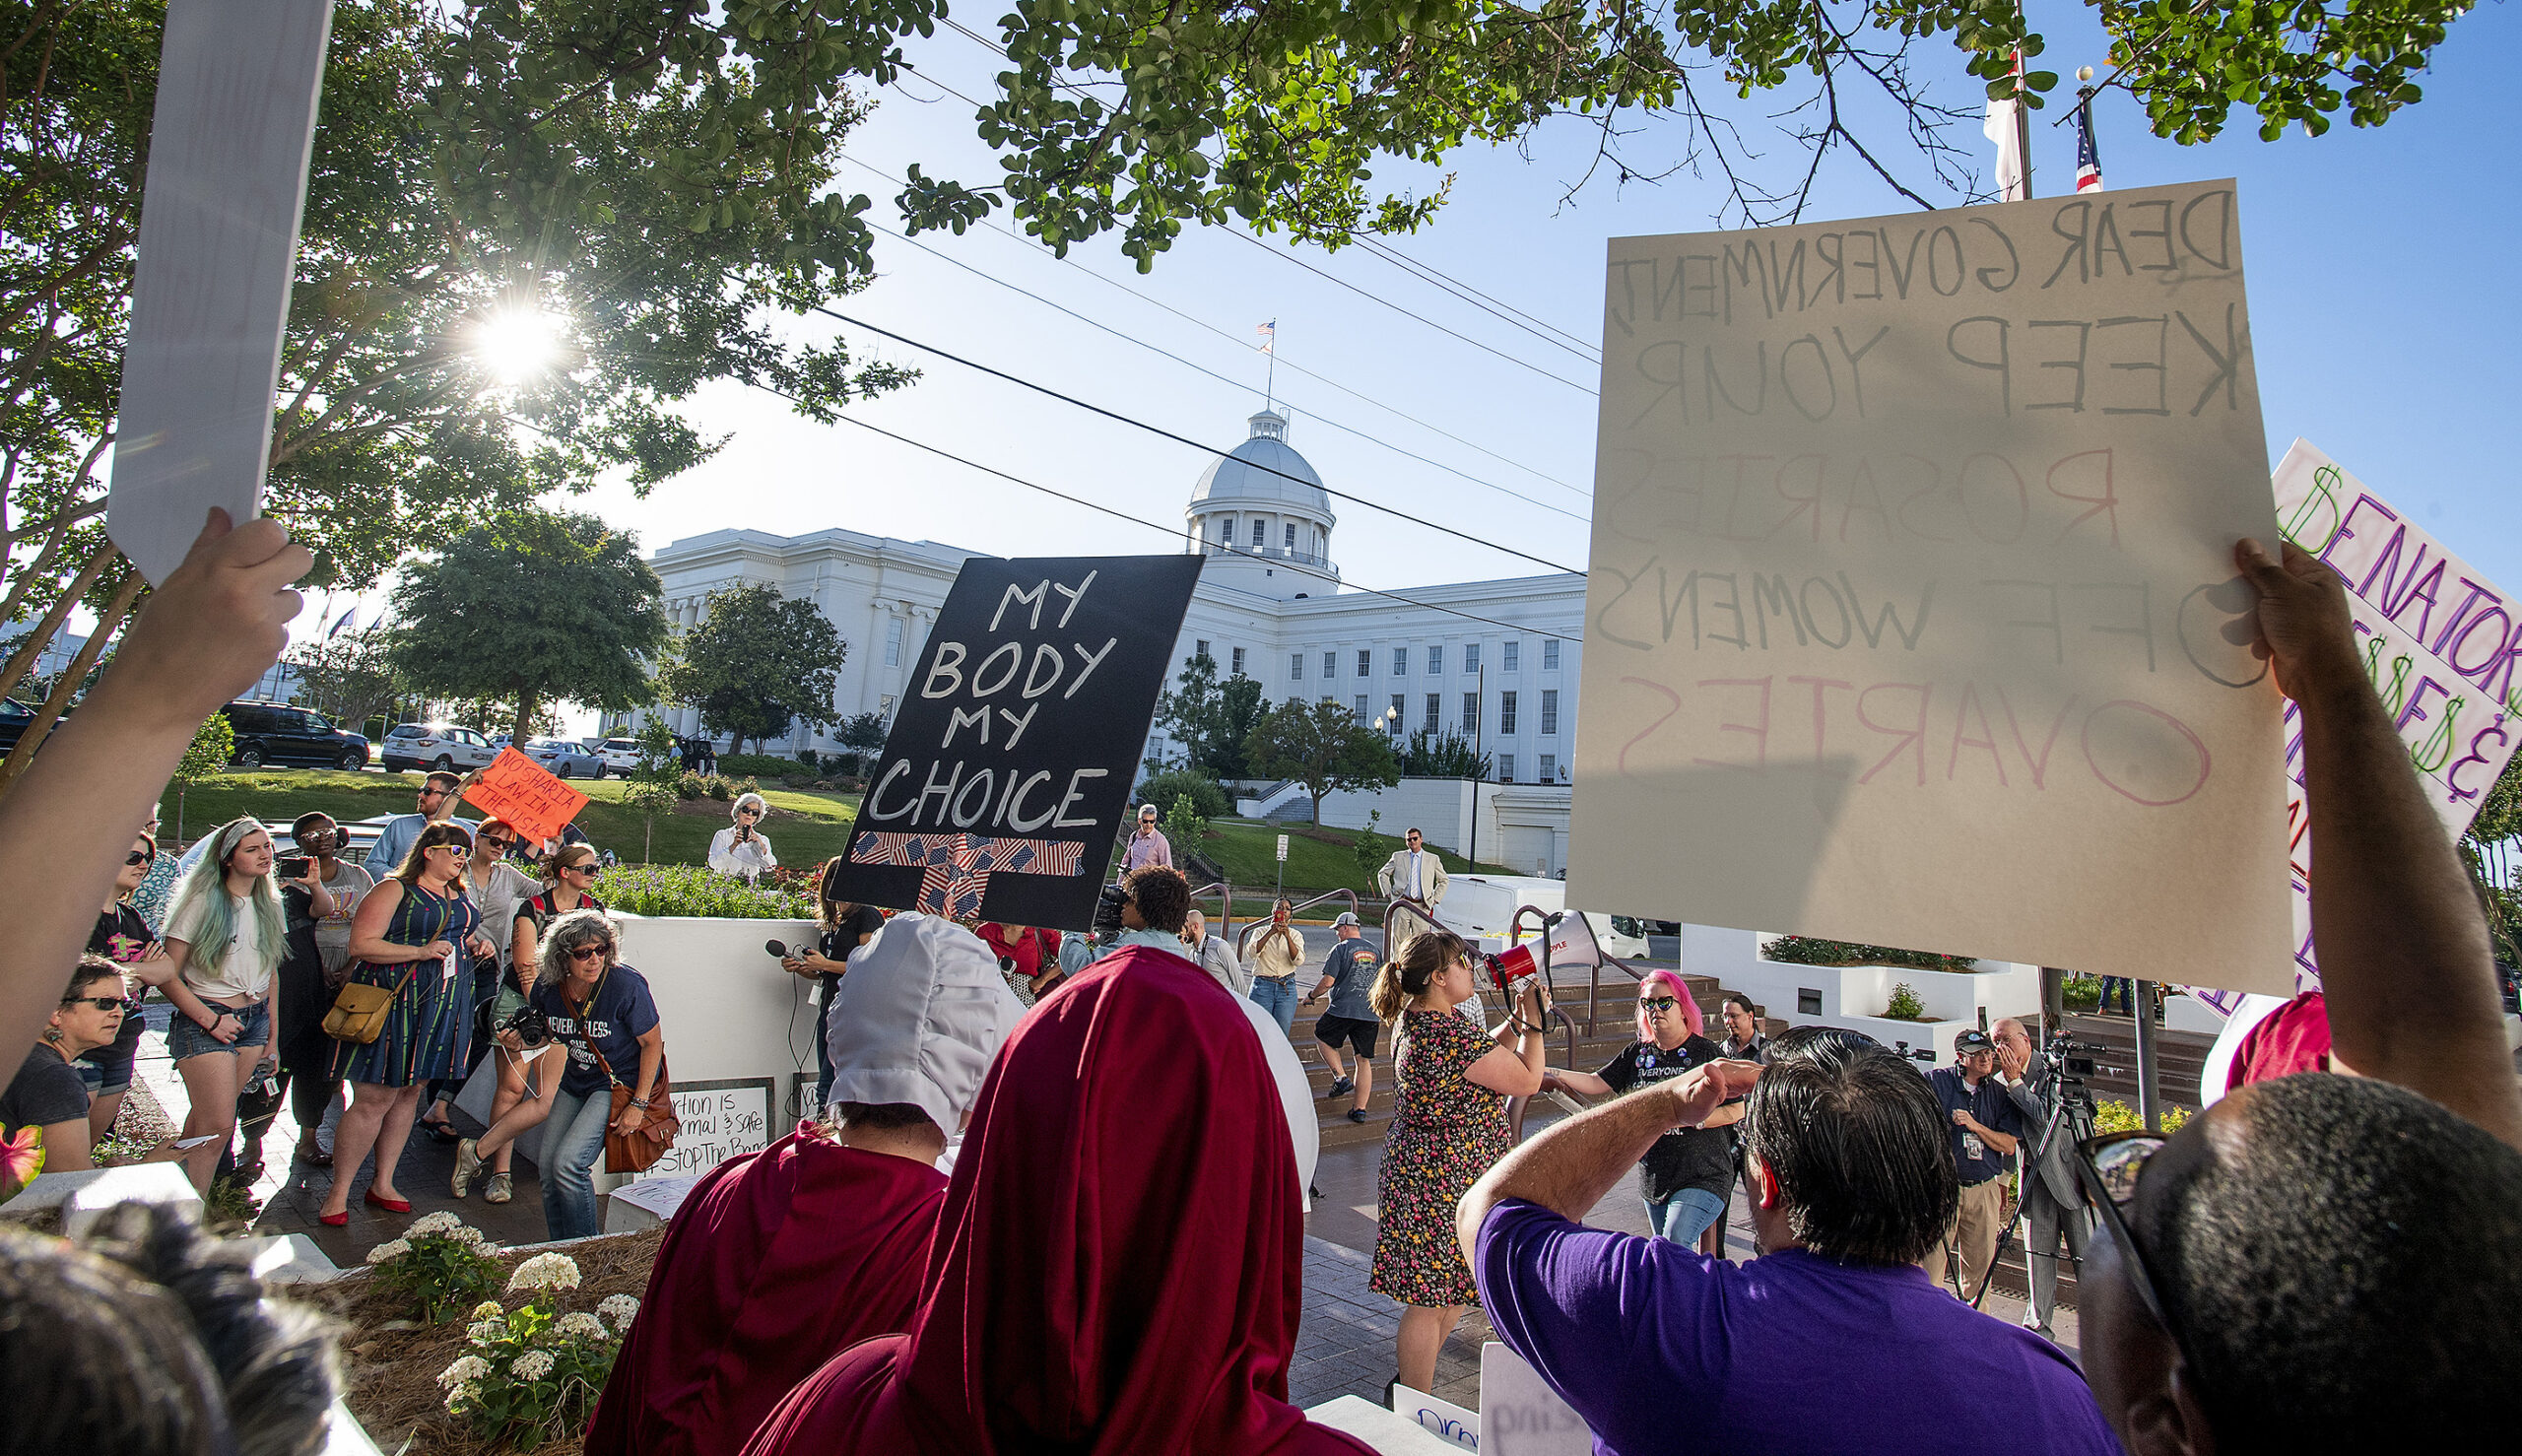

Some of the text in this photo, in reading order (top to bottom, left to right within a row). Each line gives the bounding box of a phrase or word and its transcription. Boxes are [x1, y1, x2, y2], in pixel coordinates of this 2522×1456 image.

[988, 569, 1097, 632] MY
[920, 636, 1117, 700] BODY
[941, 701, 1039, 752] MY
[495, 772, 552, 816] LAW IN
[498, 752, 576, 810] NO SHARIA
[868, 758, 1109, 832] CHOICE
[477, 785, 541, 837] THE USA
